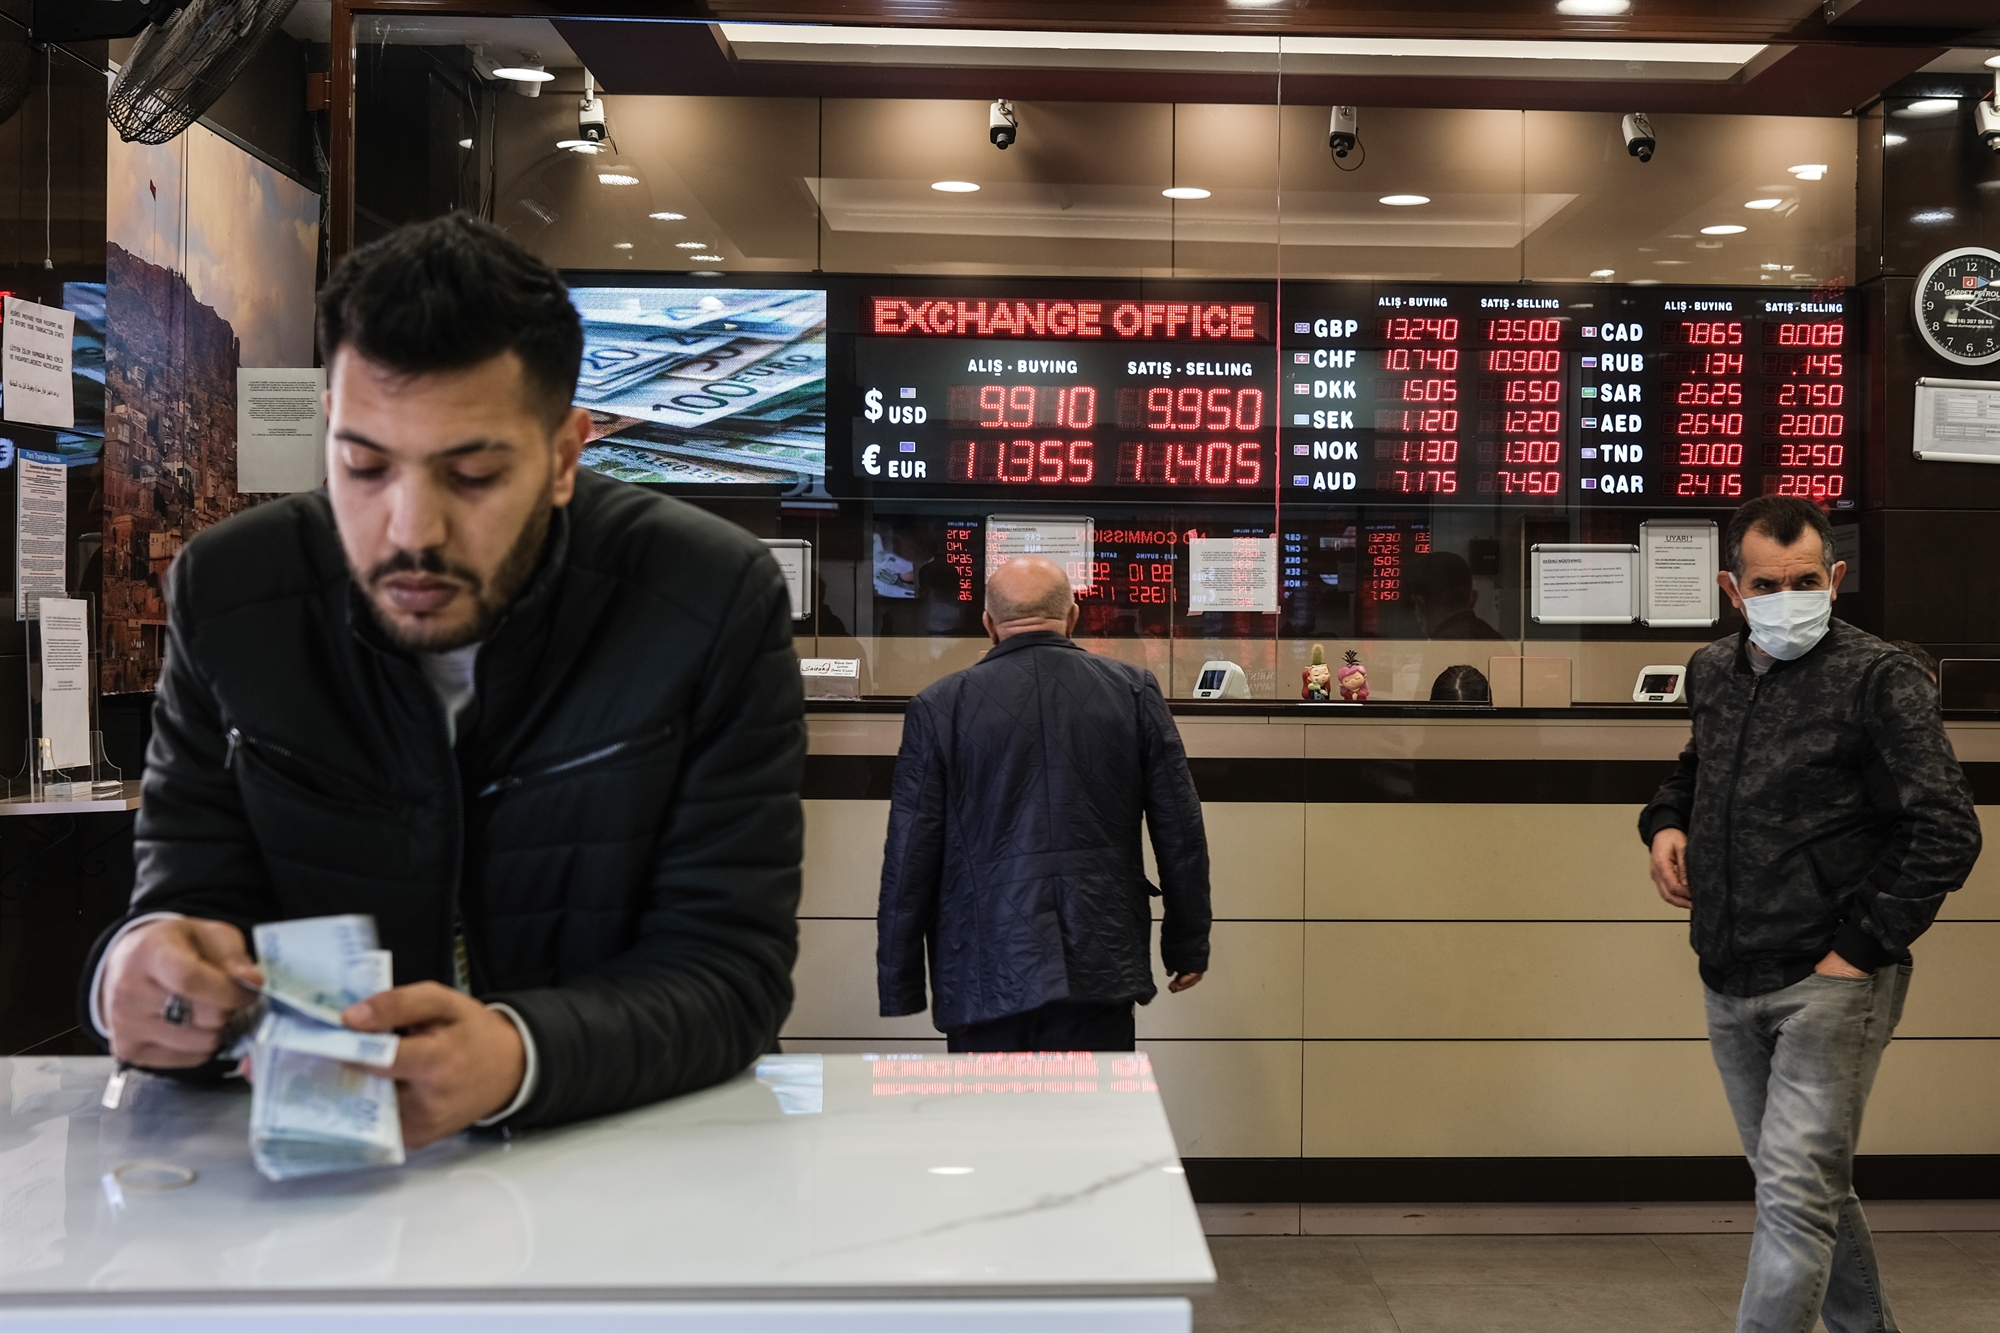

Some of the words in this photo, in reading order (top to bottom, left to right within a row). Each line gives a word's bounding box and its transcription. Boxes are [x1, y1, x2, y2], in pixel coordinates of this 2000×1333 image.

[1948, 268, 1956, 277] 11
[1966, 262, 1978, 272] 12
[1934, 282, 1945, 291] 10
[1379, 297, 1401, 308] ALIŞ
[1409, 298, 1447, 307] BUYING
[1481, 299, 1509, 310] SATIŞ
[1517, 299, 1559, 308] SELLING
[1665, 301, 1686, 312] ALIŞ
[1695, 302, 1732, 311] BUYING
[1766, 303, 1793, 314] SATIŞ
[1799, 303, 1842, 312] SELLING
[1927, 302, 1934, 310] 9
[875, 301, 1101, 335] EXCHANGE
[1114, 305, 1254, 337] OFFICE
[1932, 322, 1940, 331] 8
[1314, 319, 1357, 337] GBP
[1387, 319, 1458, 340] 13.240
[1490, 319, 1560, 342] 13.500
[1601, 323, 1642, 341] CAD
[1682, 323, 1742, 344] 7.865
[1946, 337, 1954, 346] 7
[1966, 344, 1974, 352] 6
[1986, 338, 1994, 347] 5
[968, 359, 1002, 376] ALIŞ
[1018, 360, 1077, 374] BUYING
[1128, 361, 1171, 378] SATIŞ
[1186, 362, 1252, 376] SELLING
[1314, 350, 1356, 368] CHF
[1387, 349, 1458, 371] 10.740
[1489, 350, 1560, 372] 10.900
[1602, 354, 1643, 372] RUB
[1692, 353, 1743, 374] .134
[1793, 355, 1842, 376] .145
[653, 382, 758, 415] 100
[735, 354, 812, 385] EURO
[1314, 380, 1356, 399] DKK
[1403, 380, 1457, 402] 1.505
[1506, 381, 1560, 403] 1.650
[1601, 384, 1641, 402] SAR
[1679, 383, 1741, 404] 2.625
[1779, 385, 1843, 406] 2.750
[865, 388, 883, 423] $
[889, 406, 926, 424] USD
[980, 386, 1096, 428] 9.910
[1148, 388, 1262, 430] 9.950
[1313, 410, 1353, 429] SEK
[1403, 410, 1457, 432] 1.120
[1506, 411, 1560, 432] 1.220
[1601, 414, 1641, 432] AED
[1678, 414, 1742, 435] 2.640
[1779, 415, 1843, 436] 2.800
[862, 444, 880, 475] €
[889, 461, 926, 478] EUR
[968, 440, 1093, 482] 11.355
[1314, 441, 1358, 460] NOK
[1403, 440, 1457, 462] 1.130
[1505, 441, 1560, 463] 1.300
[1600, 445, 1642, 462] TND
[1680, 444, 1742, 465] 3.000
[1781, 445, 1843, 466] 3.250
[1136, 442, 1260, 484] 11.405
[1313, 472, 1356, 490] AUD
[1396, 471, 1456, 492] 7.175
[1498, 472, 1560, 494] 7.450
[1601, 475, 1643, 494] QAR
[1678, 474, 1741, 495] 2.415
[1779, 475, 1843, 496] 2.850
